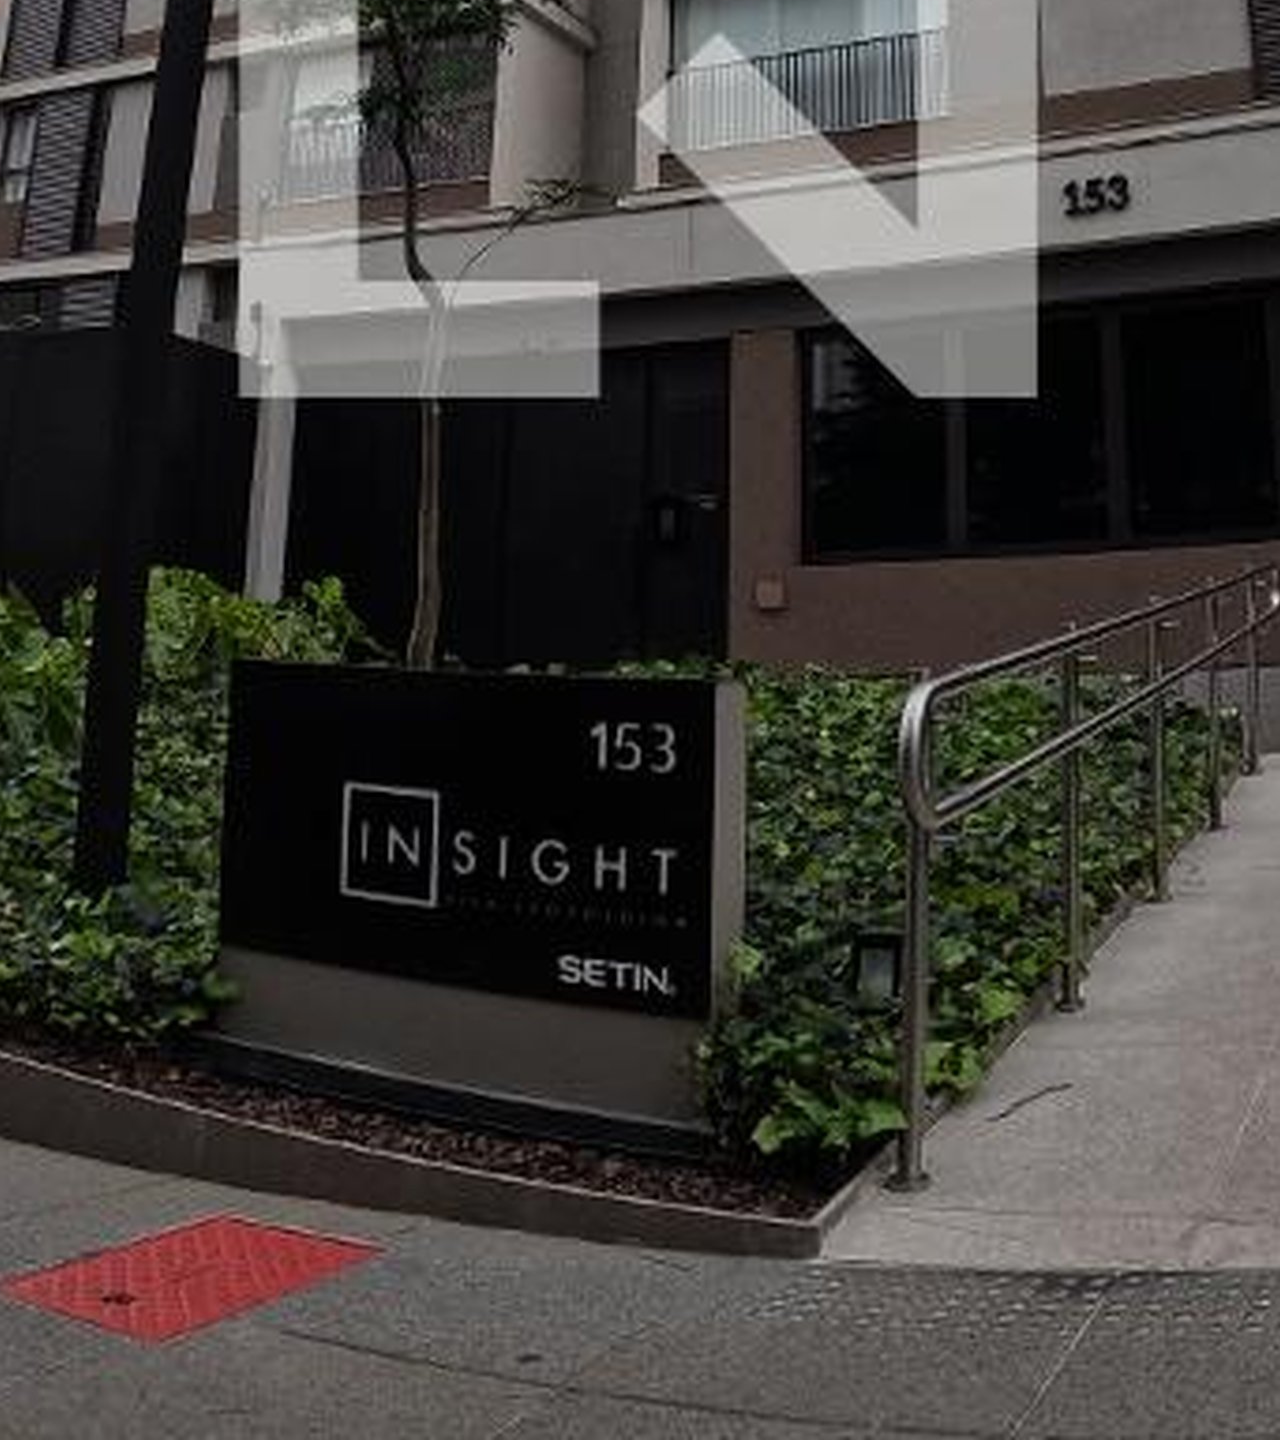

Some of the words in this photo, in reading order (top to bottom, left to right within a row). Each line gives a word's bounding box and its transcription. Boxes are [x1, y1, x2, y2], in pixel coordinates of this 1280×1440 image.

[1063, 173, 1131, 217] 153
[589, 721, 677, 775] 153
[358, 818, 679, 896] INSIGHT
[556, 953, 671, 995] SETIN
